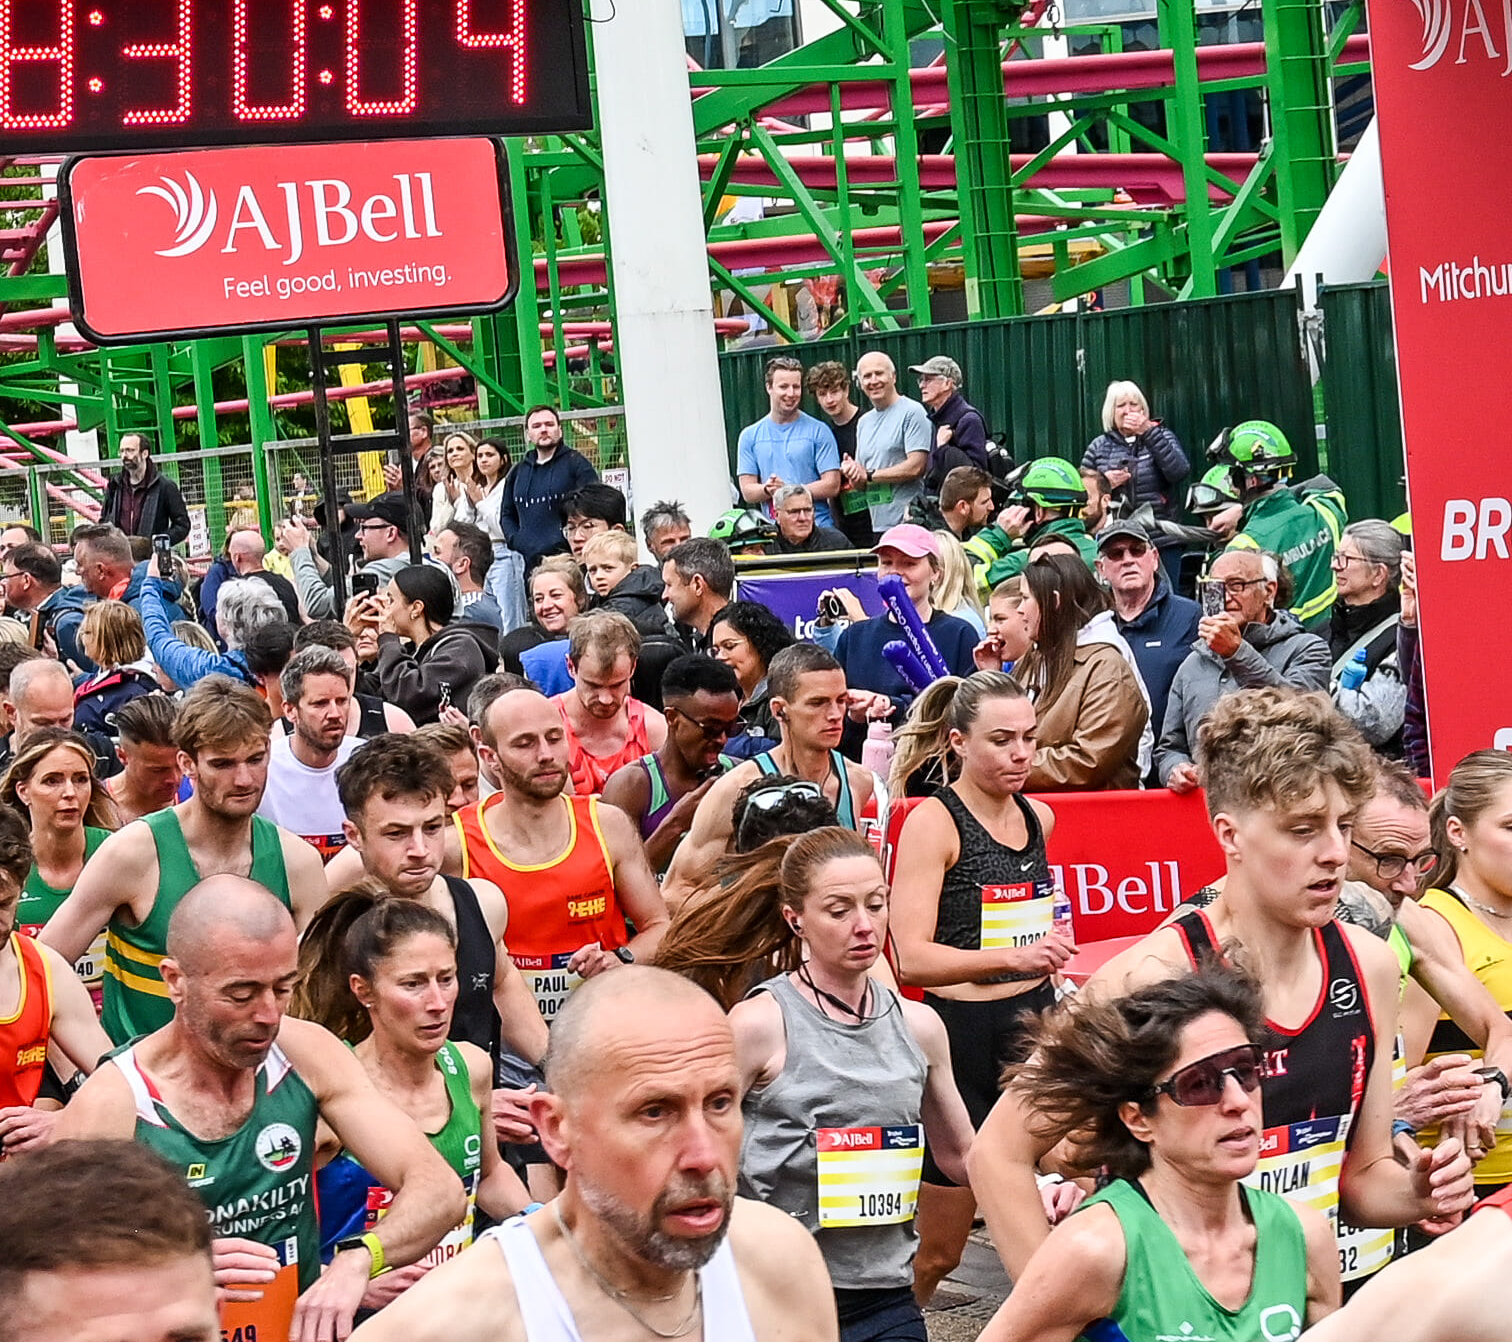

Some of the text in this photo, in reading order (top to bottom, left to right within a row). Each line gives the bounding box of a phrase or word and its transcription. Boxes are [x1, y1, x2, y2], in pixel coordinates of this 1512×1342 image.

[221, 171, 443, 265] AJBell
[223, 263, 453, 300] Feel good, investing.
[534, 975, 570, 994] PAUL
[842, 1133, 873, 1148] AJBell
[1261, 1161, 1309, 1193] DYLAN
[205, 1175, 309, 1227] ONAKILTY
[859, 1193, 902, 1217] 10394
